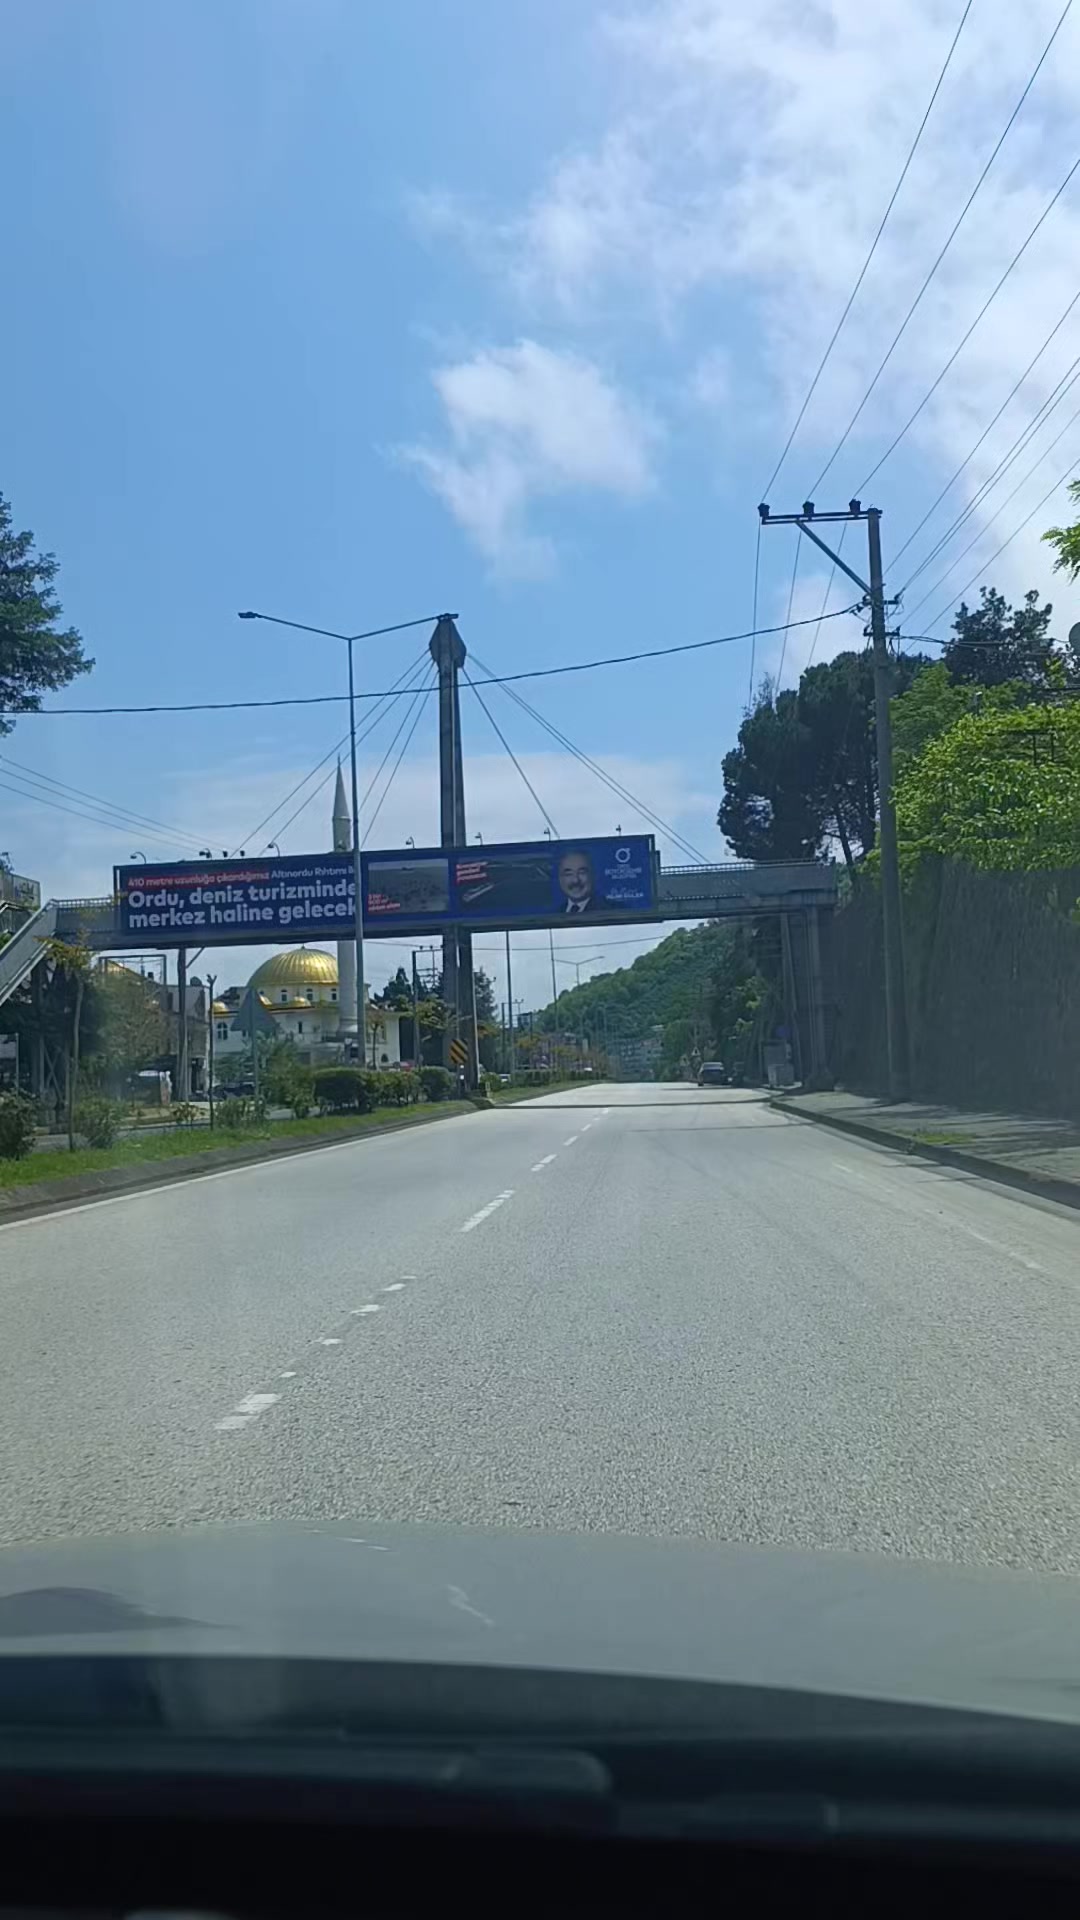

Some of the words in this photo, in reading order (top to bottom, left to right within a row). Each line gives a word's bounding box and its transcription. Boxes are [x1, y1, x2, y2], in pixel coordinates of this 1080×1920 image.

[128, 878, 145, 887] 410
[146, 877, 173, 886] metre
[128, 889, 184, 908] Ordu,
[189, 885, 244, 904] deniz
[248, 879, 356, 901] turizminde
[129, 908, 206, 928] merkez
[210, 902, 274, 923] haline
